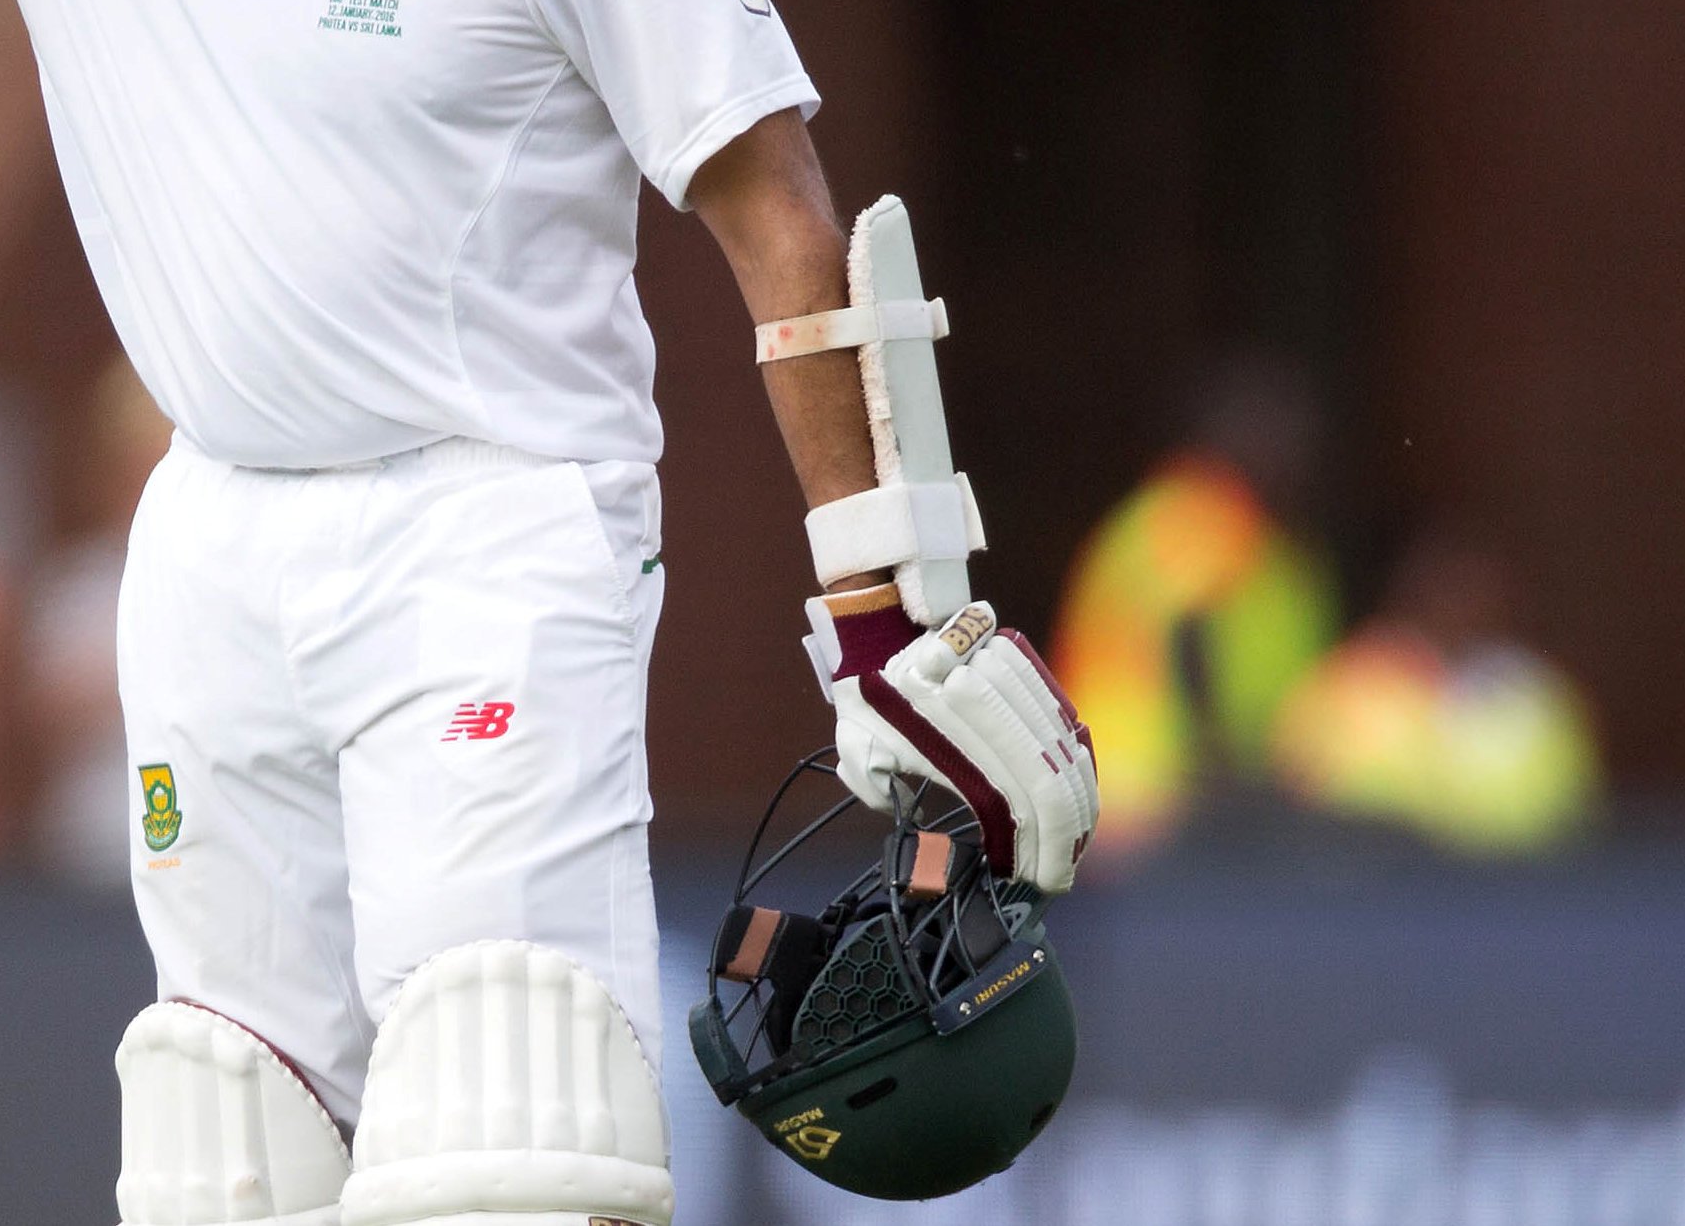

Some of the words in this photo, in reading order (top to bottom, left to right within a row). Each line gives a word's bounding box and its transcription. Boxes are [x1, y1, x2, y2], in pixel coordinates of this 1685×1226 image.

[318, 16, 346, 30] PROTEA
[347, 20, 359, 32] VS
[360, 22, 374, 35] SRI
[376, 23, 402, 37] LANKA
[440, 701, 515, 742] NB
[975, 961, 1030, 1005] MASURI
